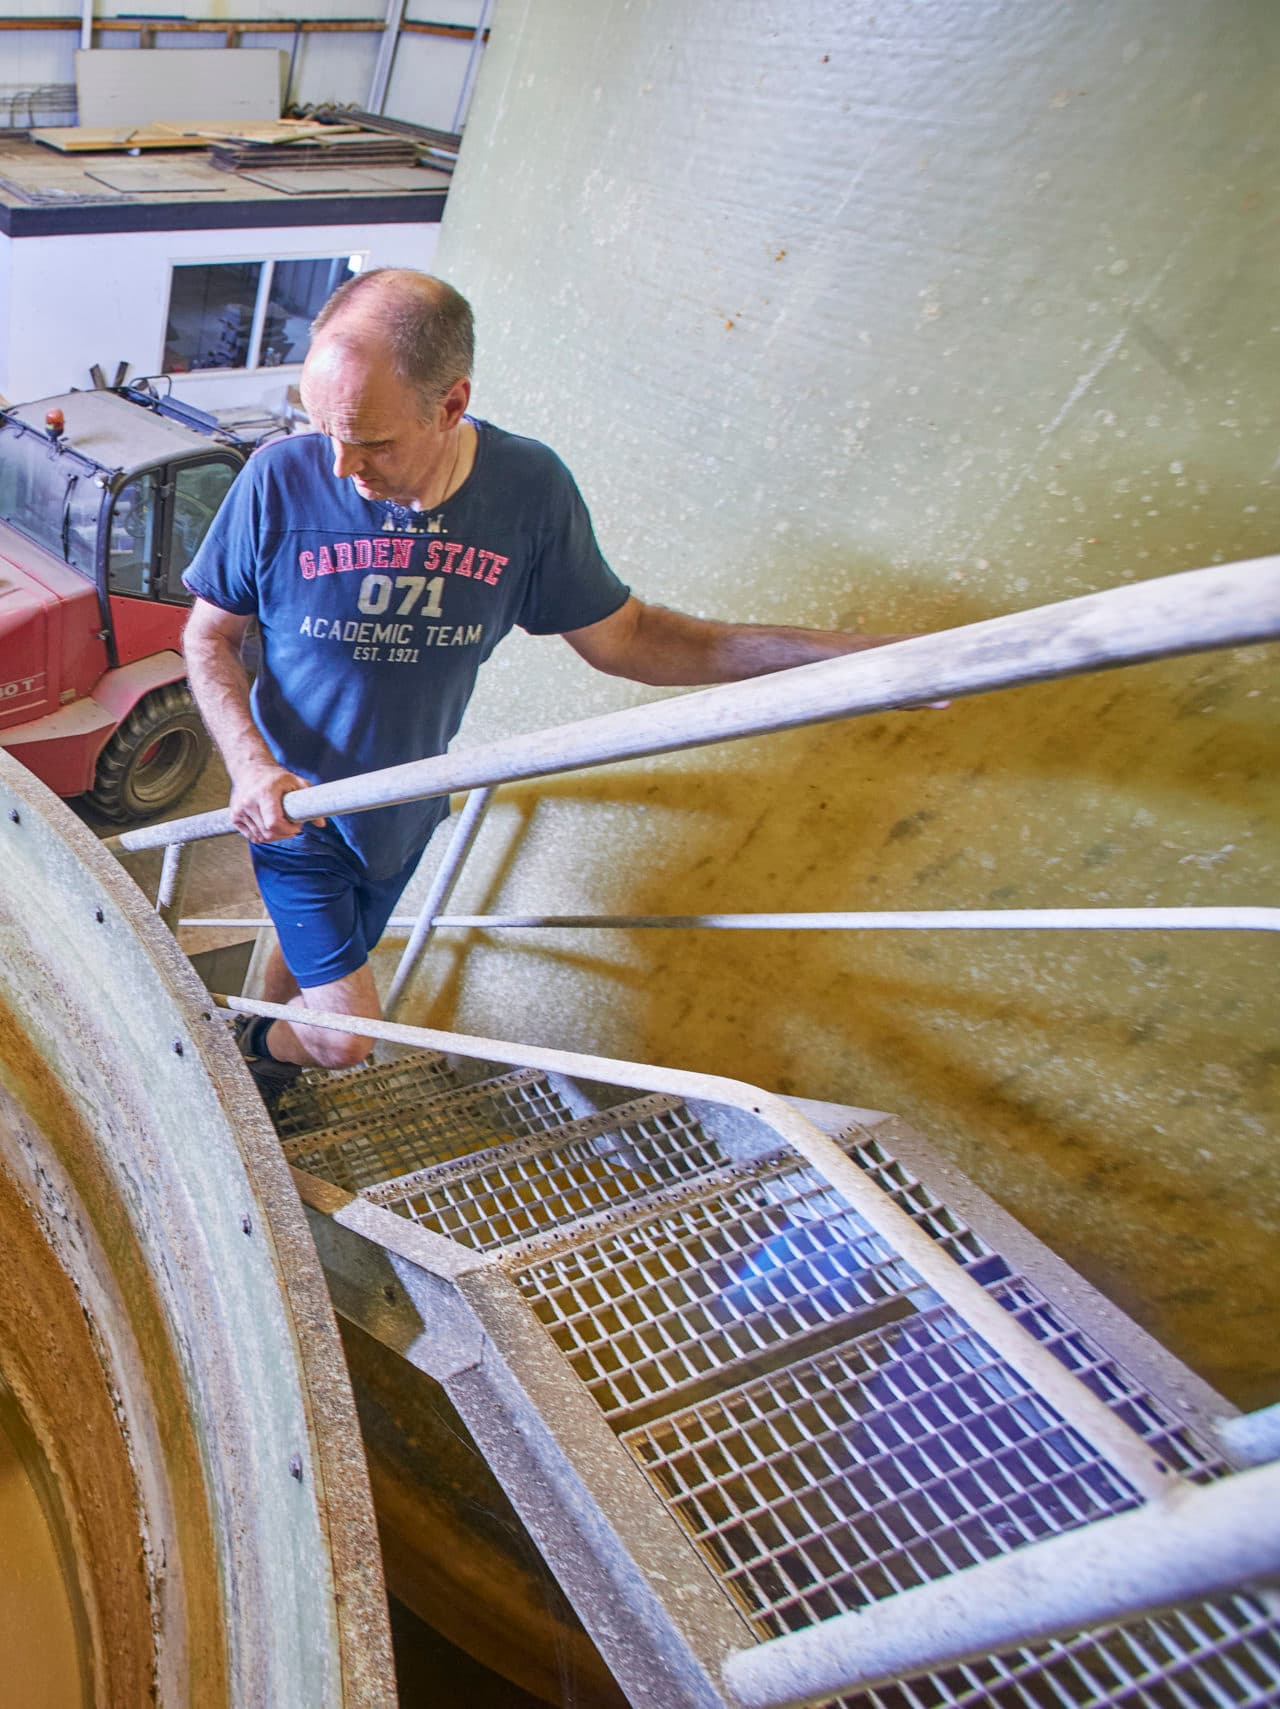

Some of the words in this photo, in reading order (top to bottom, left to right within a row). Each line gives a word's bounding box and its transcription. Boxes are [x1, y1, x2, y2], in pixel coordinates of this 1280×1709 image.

[299, 538, 415, 580] GARDEN
[424, 540, 509, 586] STATE
[357, 574, 446, 618] 071
[299, 615, 414, 645] ACADEMIC
[426, 623, 483, 647] TEAM
[353, 646, 381, 662] EST.
[387, 647, 420, 663] 1971
[22, 679, 35, 691] T
